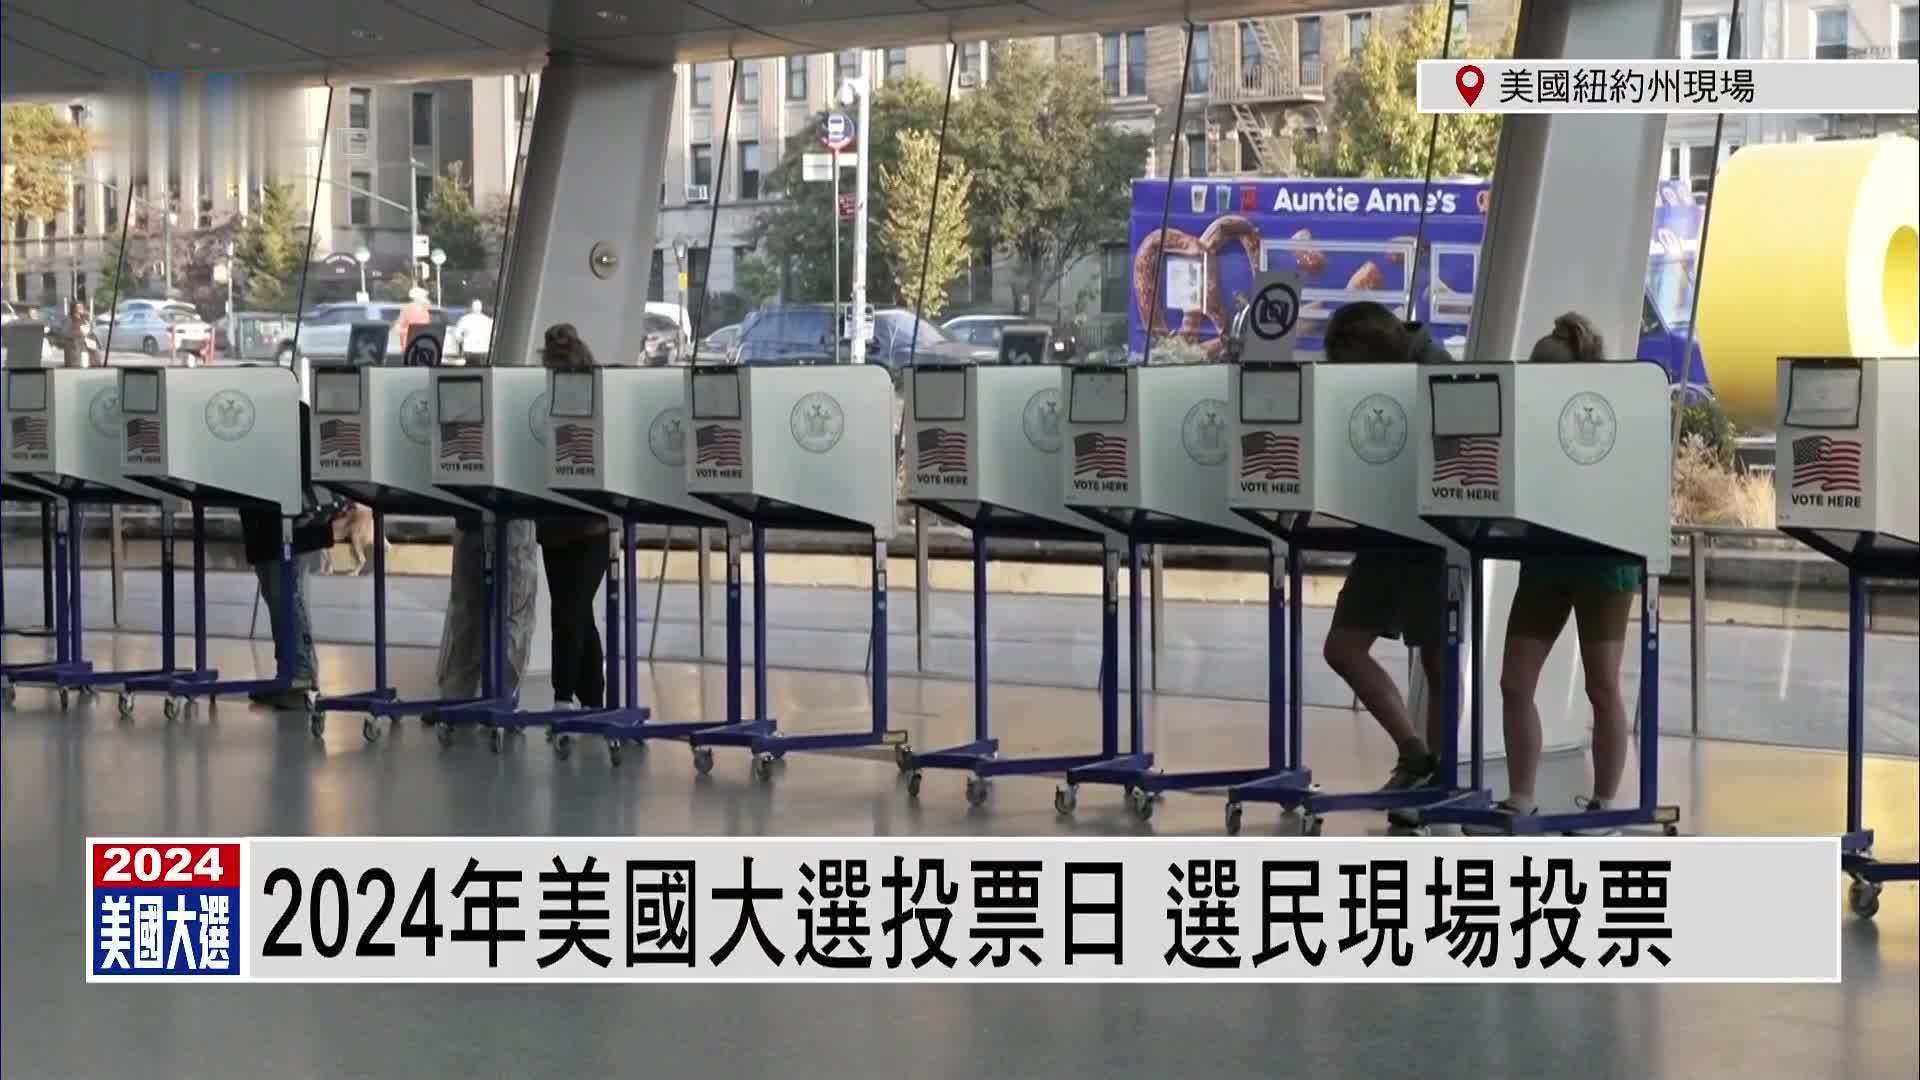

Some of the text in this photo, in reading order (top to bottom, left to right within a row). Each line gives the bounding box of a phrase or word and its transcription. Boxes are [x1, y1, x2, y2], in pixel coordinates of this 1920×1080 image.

[1273, 186, 1458, 214] Auntie Anne's
[320, 459, 339, 468] VOTE
[440, 463, 460, 471] VOTE
[555, 467, 574, 475] VOTE
[696, 469, 743, 478] VOTE HERE
[917, 474, 968, 485] VOTE HERE
[1074, 480, 1128, 492] VOTE HERE
[1241, 482, 1301, 494] VOTE HERE
[1432, 487, 1500, 501] VOTE HERE
[1791, 494, 1862, 508] VOTE HERE
